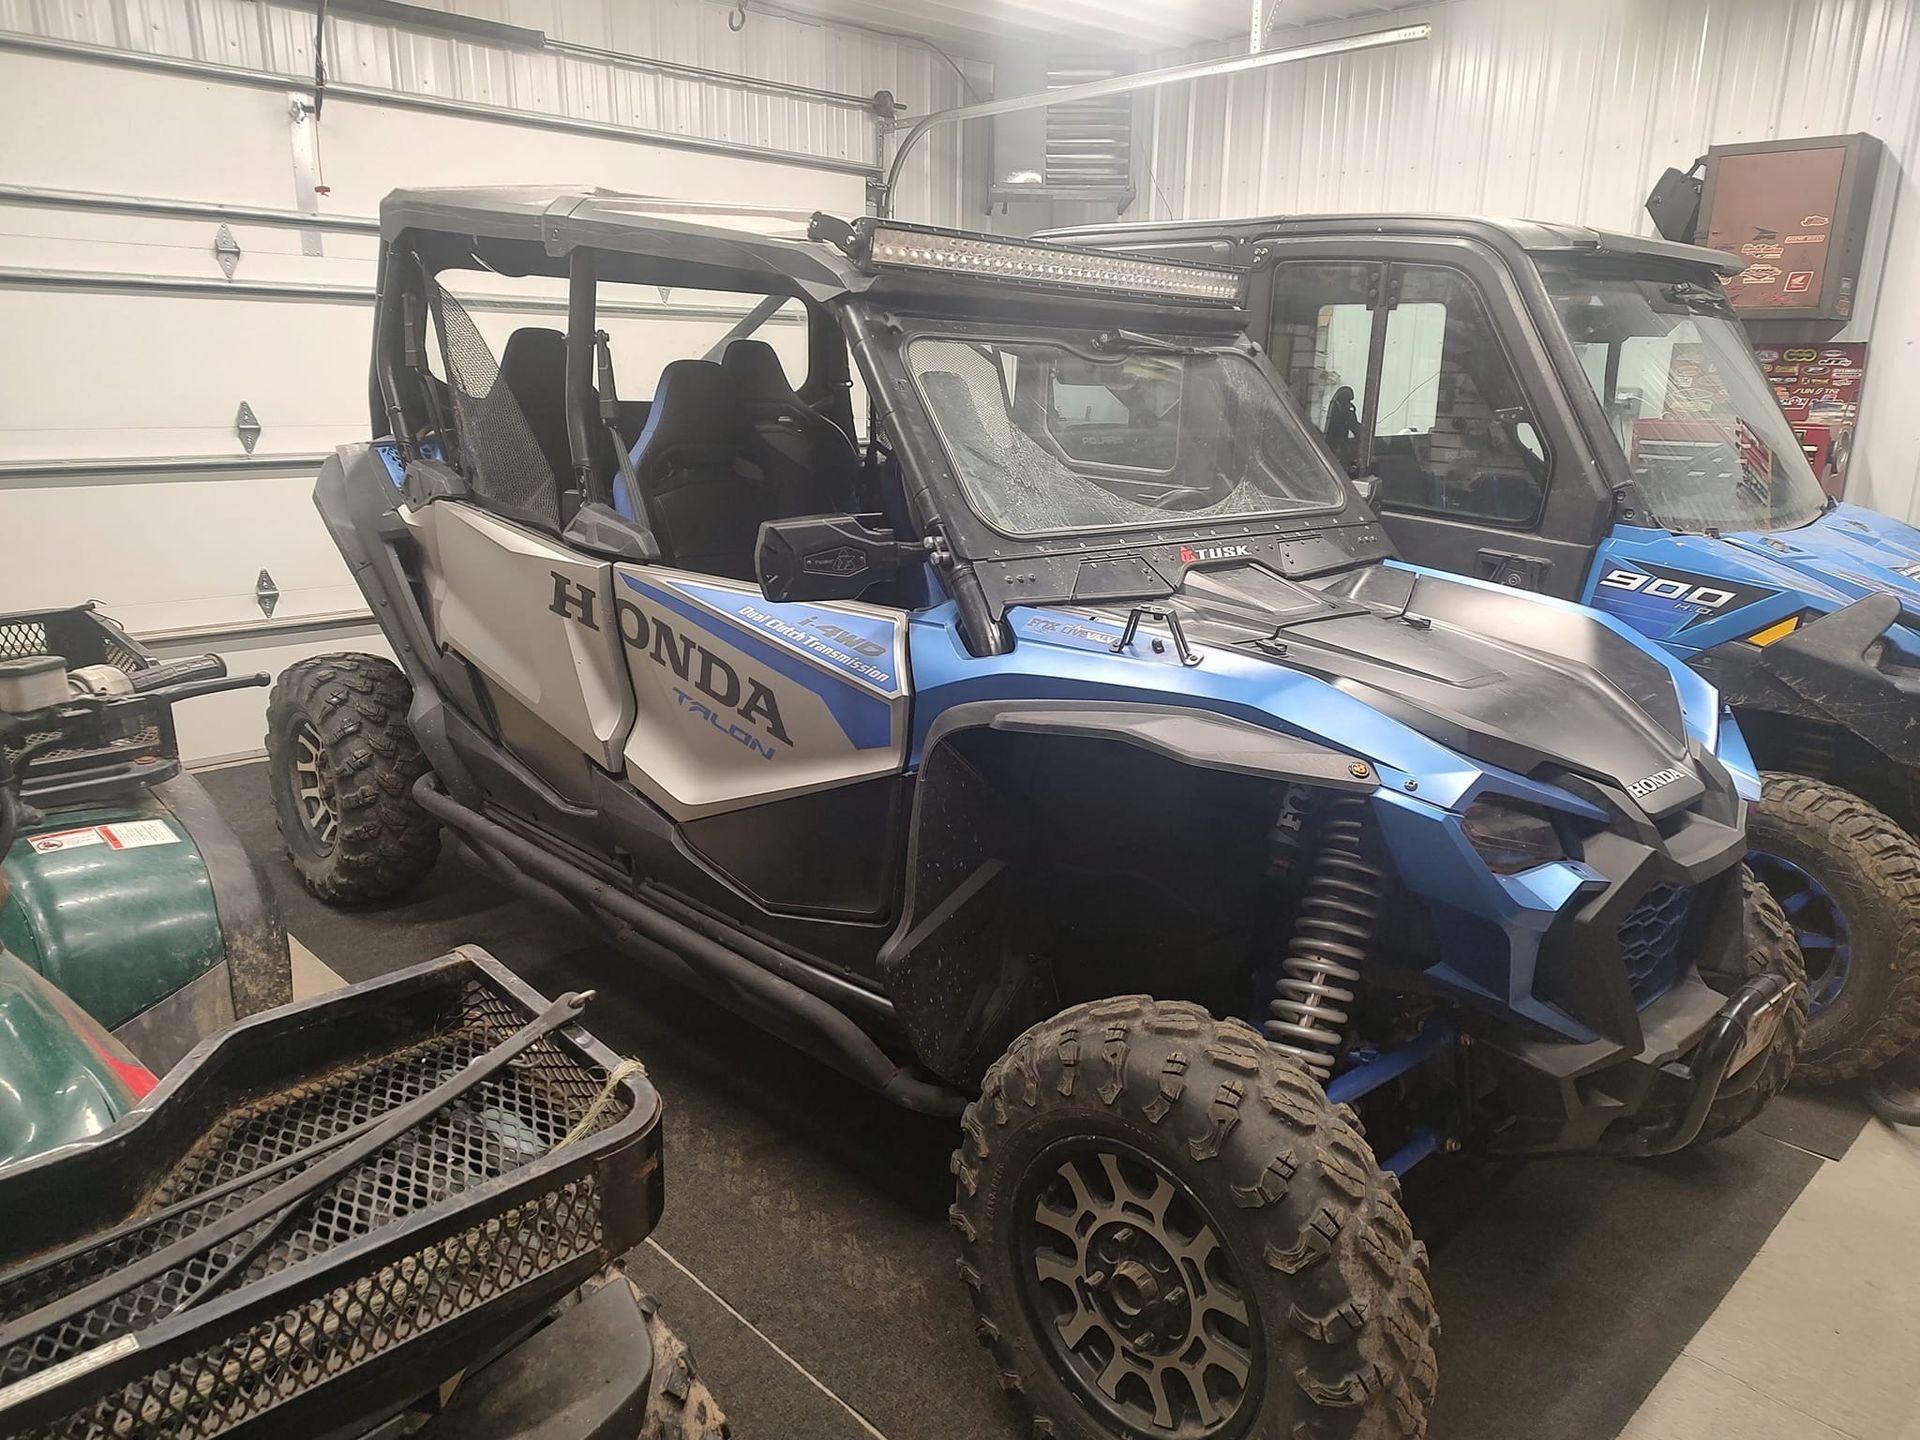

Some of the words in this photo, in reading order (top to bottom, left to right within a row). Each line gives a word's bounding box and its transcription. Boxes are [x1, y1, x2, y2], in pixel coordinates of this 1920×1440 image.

[1196, 545, 1251, 560] TUSK
[1600, 569, 1736, 607] 900
[738, 606, 764, 625] Dual
[766, 618, 806, 644] Clutch
[804, 634, 889, 682] Transmission
[801, 617, 886, 657] i-4WD
[549, 571, 794, 747] HONDA
[674, 687, 775, 760] TALON
[1628, 768, 1685, 798] HONDA
